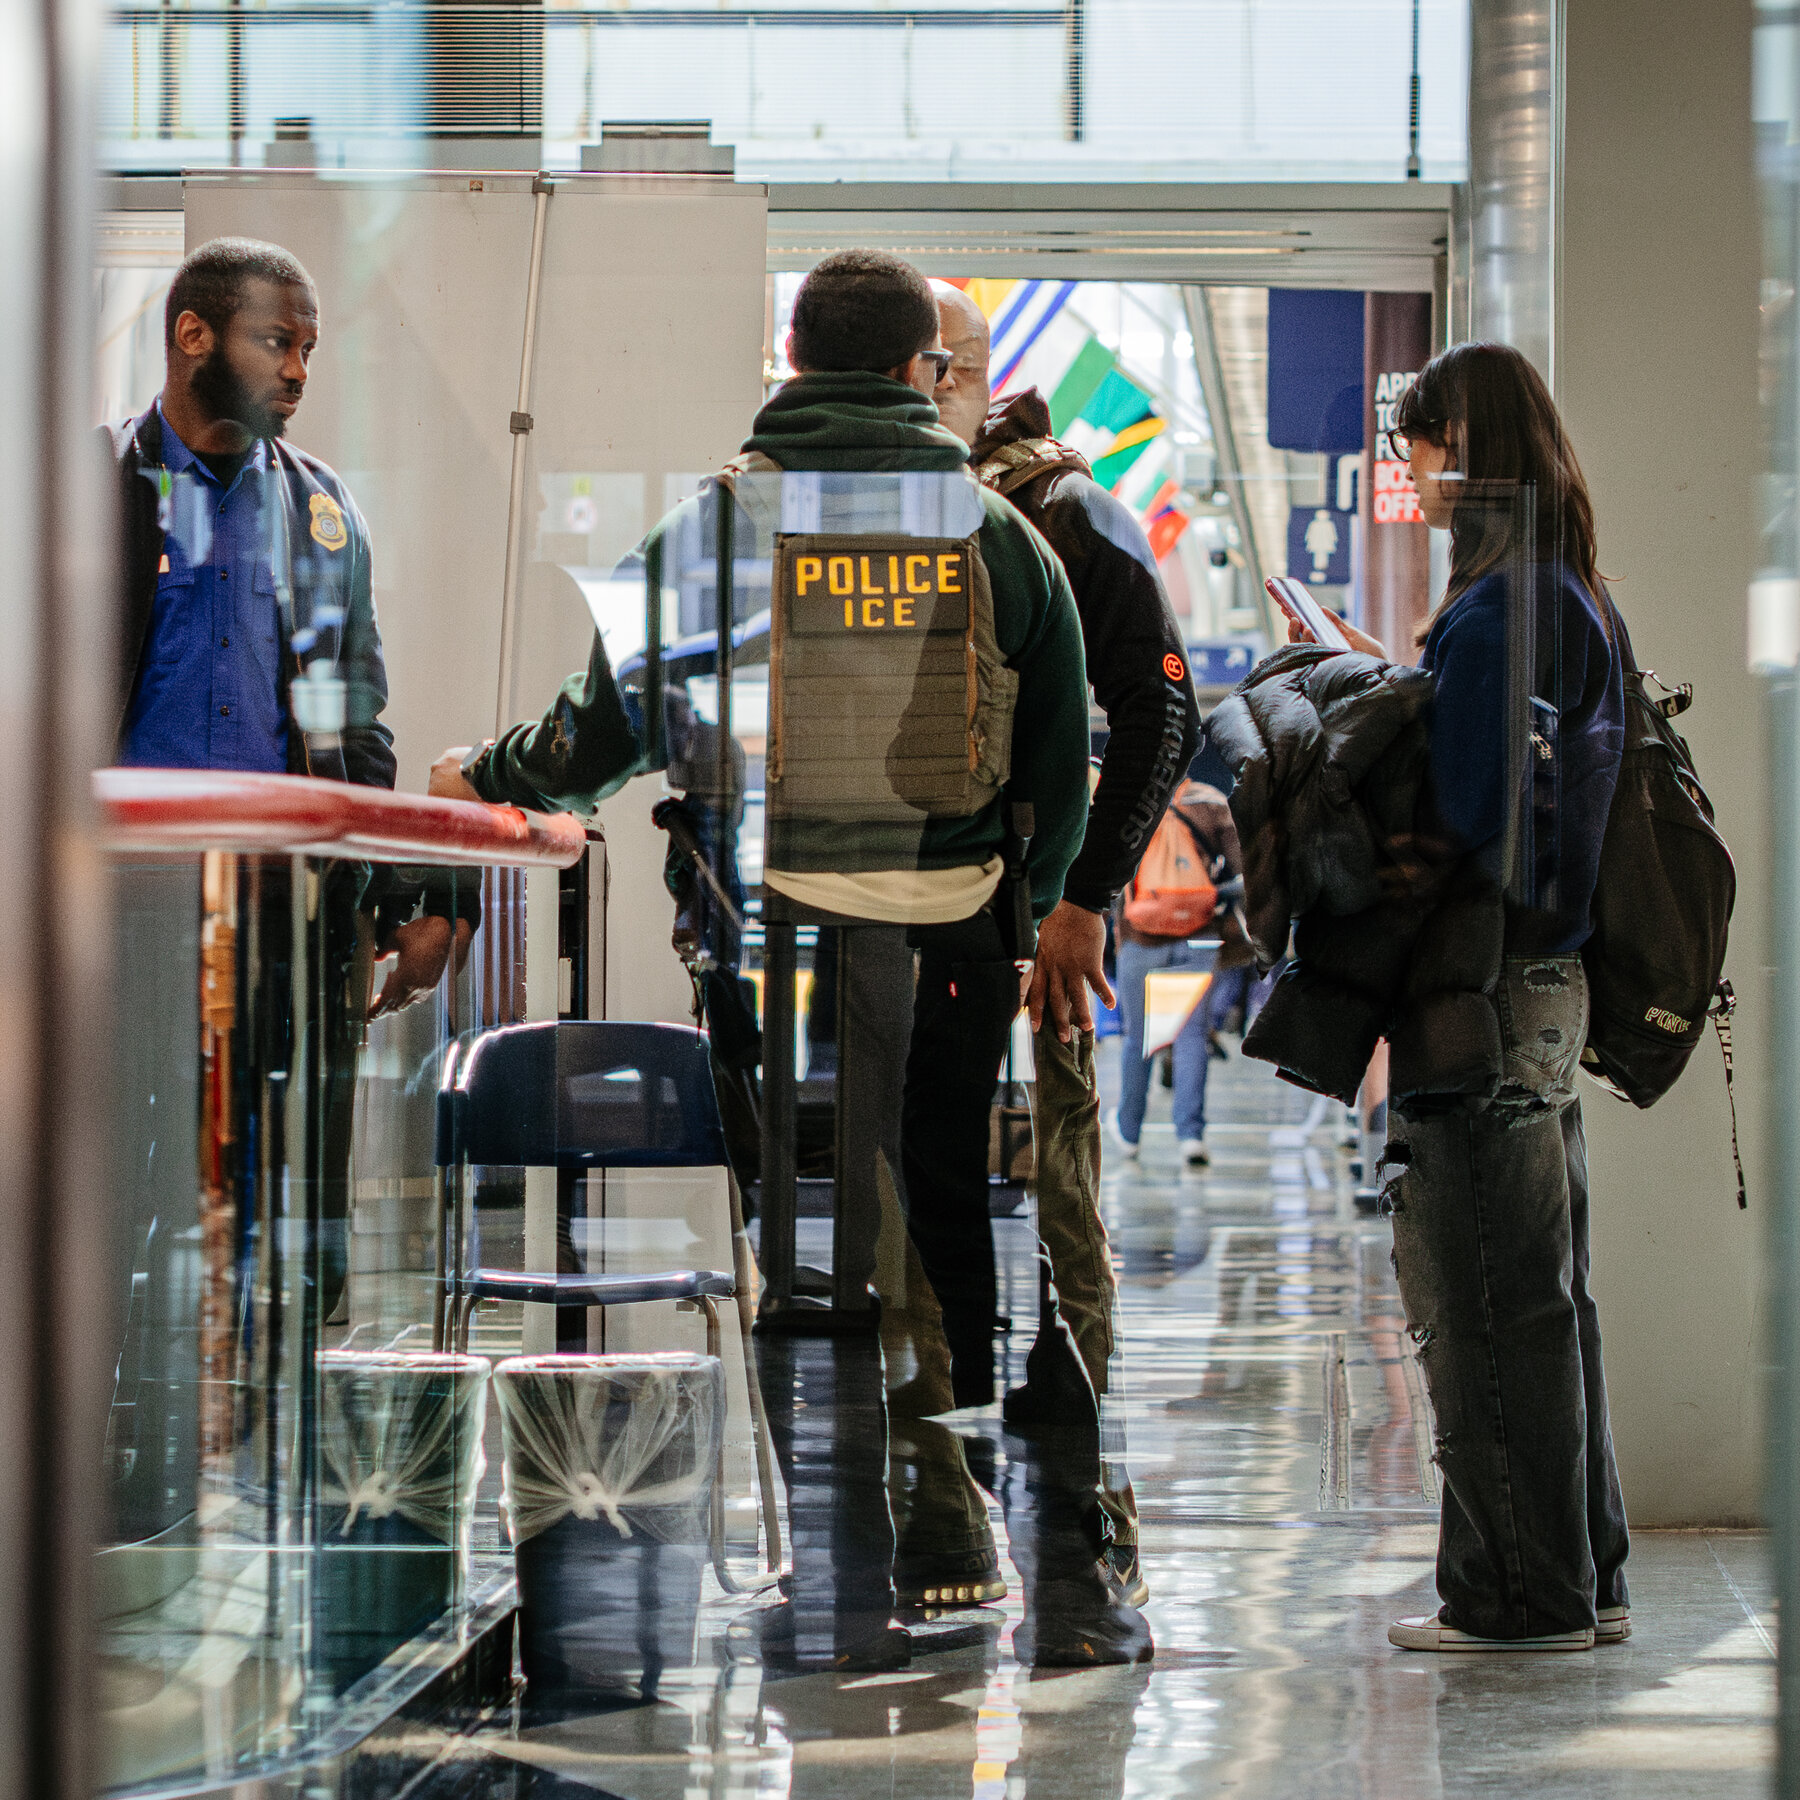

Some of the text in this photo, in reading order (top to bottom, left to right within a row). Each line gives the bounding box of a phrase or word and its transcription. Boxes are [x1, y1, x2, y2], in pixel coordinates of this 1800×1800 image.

[796, 554, 962, 596] POLICE
[844, 598, 916, 627] ICE
[1120, 681, 1187, 850] SUPERDRY
[1644, 1006, 1692, 1034] PINK
